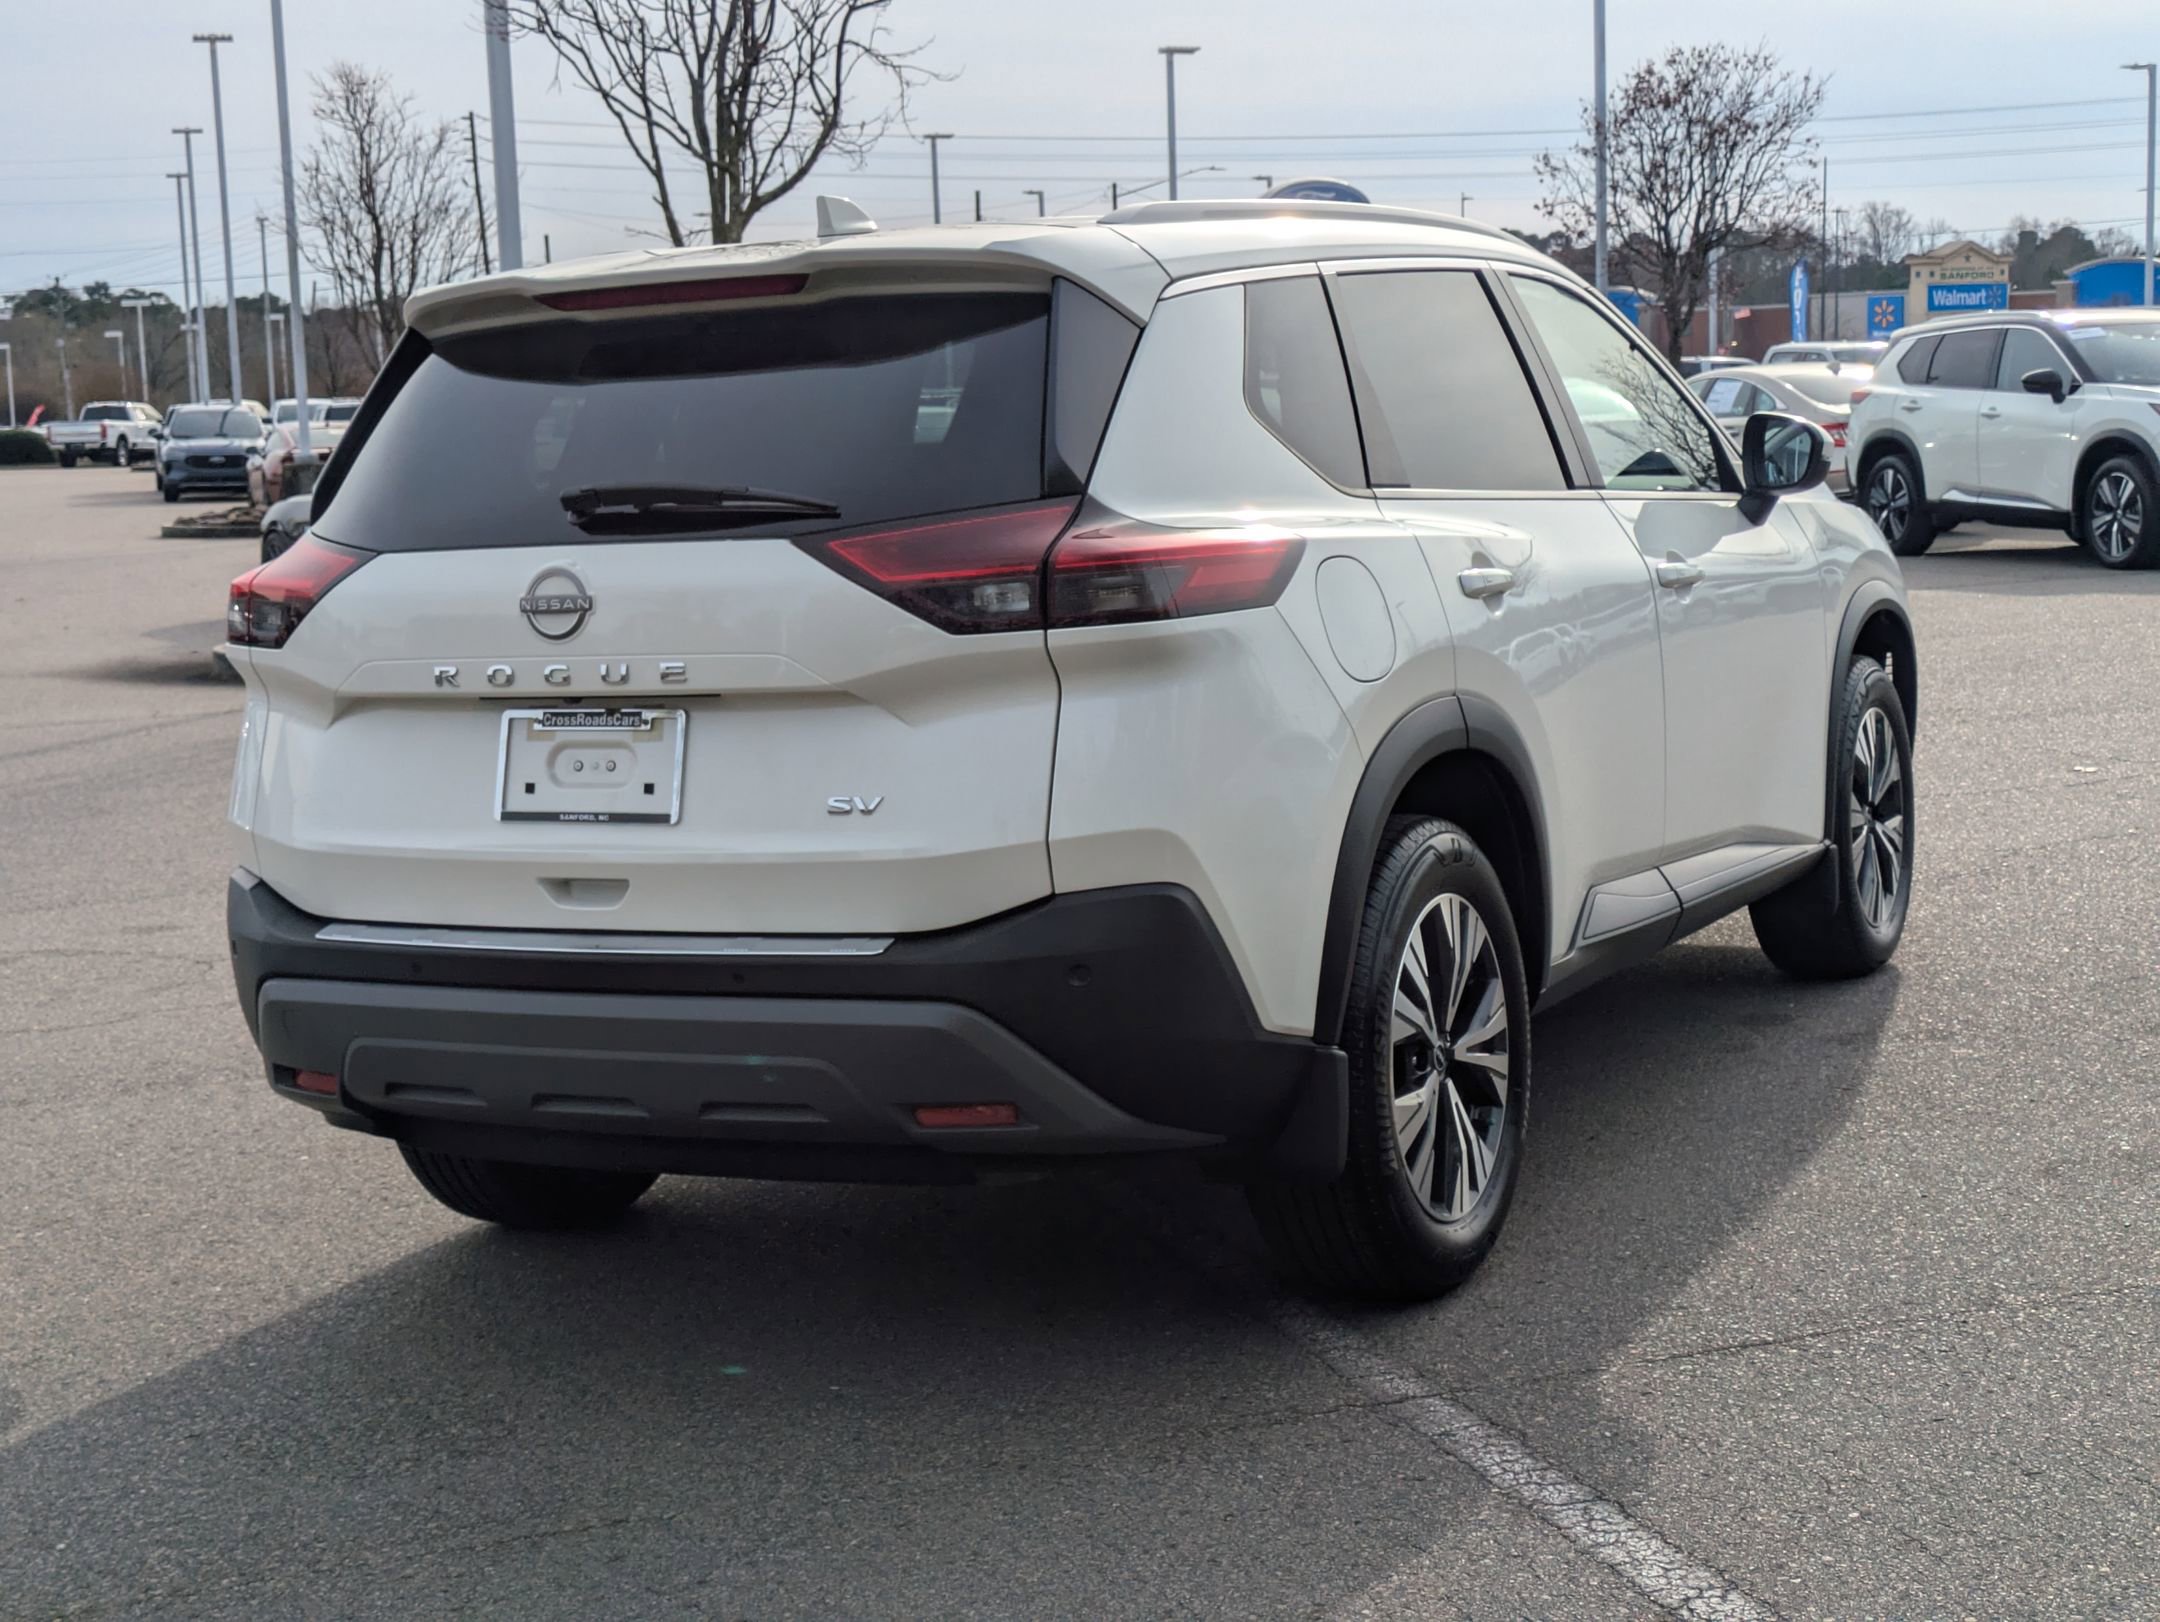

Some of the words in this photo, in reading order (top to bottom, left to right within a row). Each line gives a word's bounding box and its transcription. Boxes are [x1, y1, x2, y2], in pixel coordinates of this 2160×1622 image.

[1933, 288, 1986, 306] Walmart
[521, 598, 590, 611] NISSAN
[434, 662, 687, 687] ROGUE
[543, 713, 641, 726] CrossRoadsCars
[827, 796, 884, 815] SV
